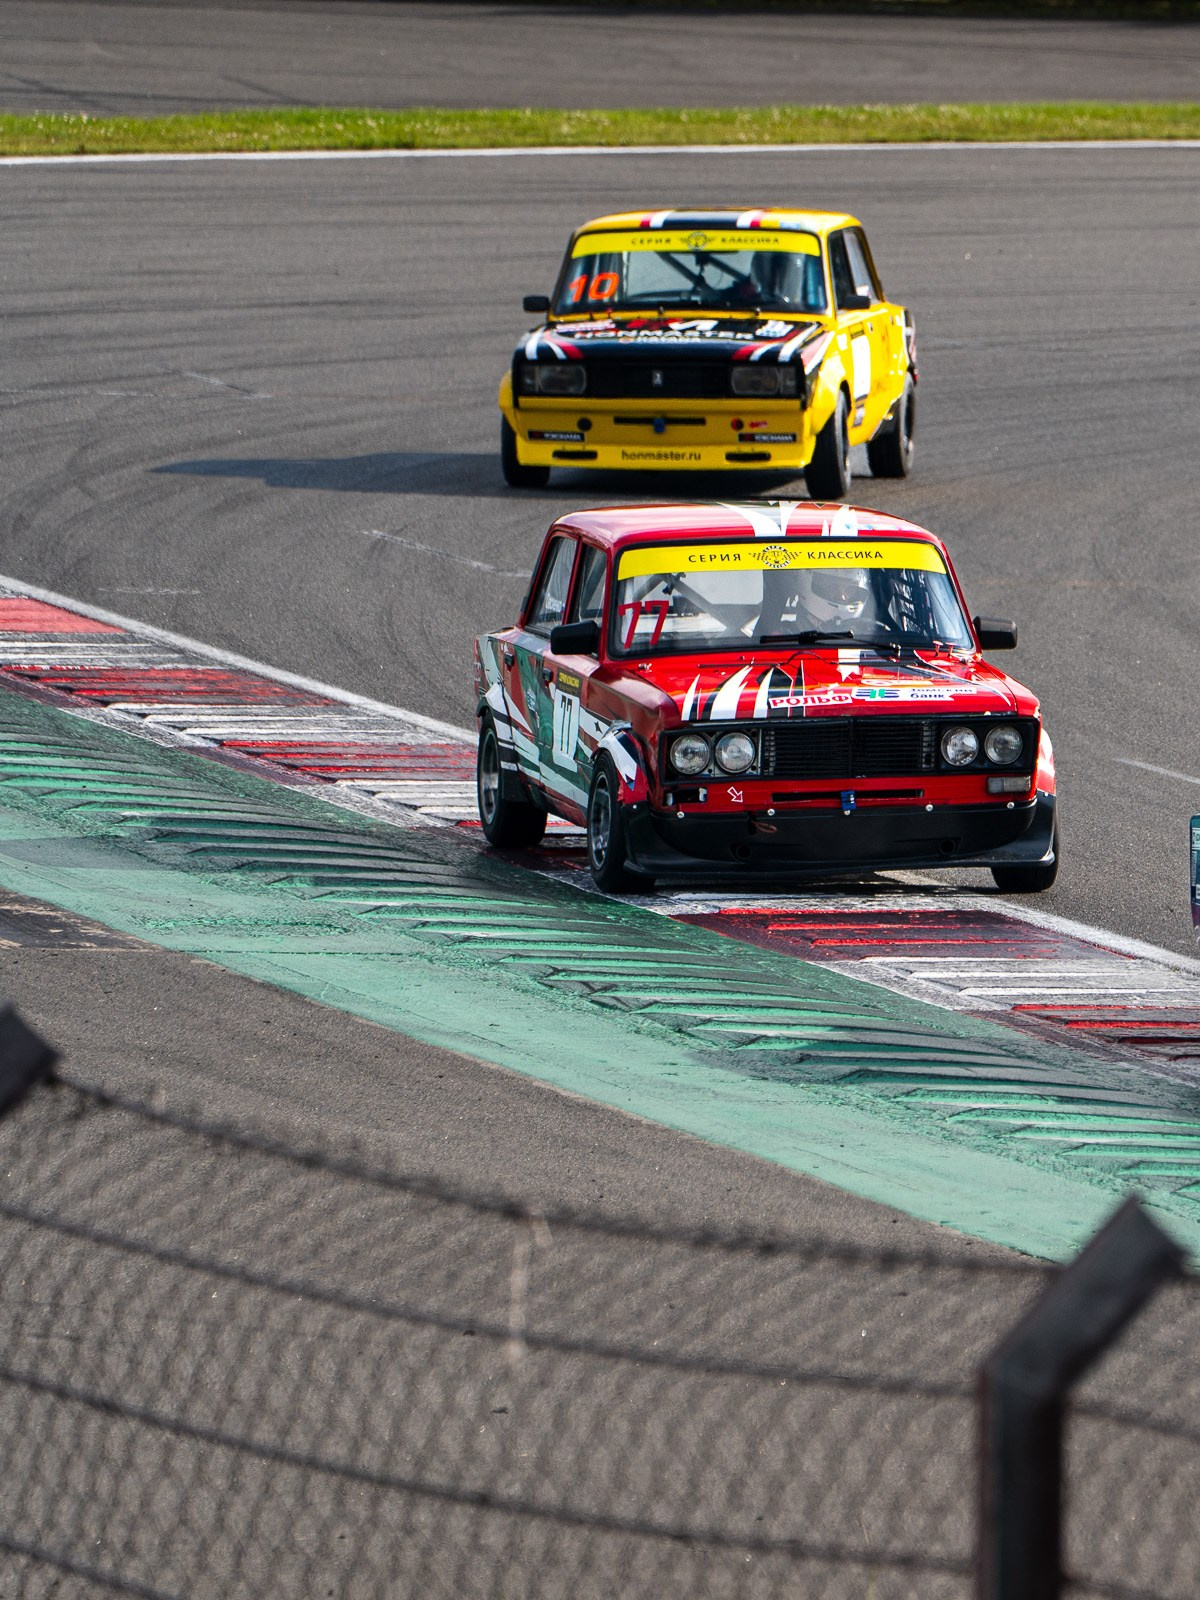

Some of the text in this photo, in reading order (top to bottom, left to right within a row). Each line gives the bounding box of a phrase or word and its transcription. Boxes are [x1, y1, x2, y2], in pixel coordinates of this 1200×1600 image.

[630, 237, 671, 245] СЕРИЯ
[569, 272, 619, 302] 10
[621, 450, 701, 461] honmaster.ru
[688, 550, 883, 563] СЕРИЯ КЛАССИКА
[618, 600, 670, 649] 77
[771, 694, 849, 707] РОЛЬФ
[561, 694, 572, 754] 77
